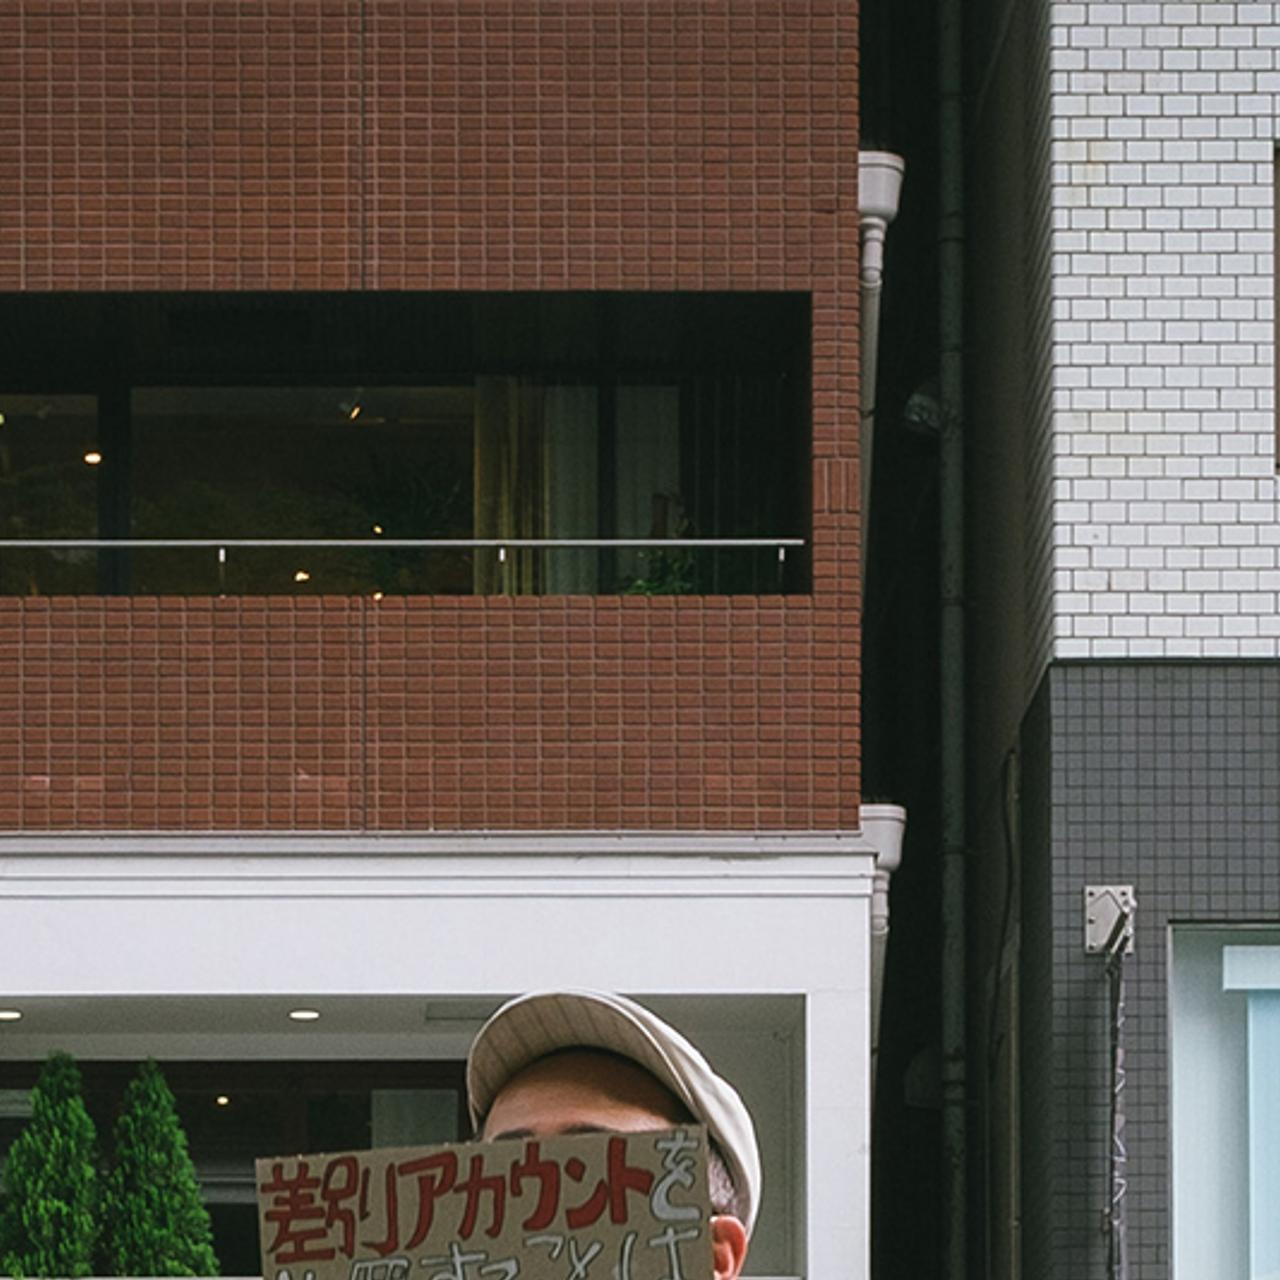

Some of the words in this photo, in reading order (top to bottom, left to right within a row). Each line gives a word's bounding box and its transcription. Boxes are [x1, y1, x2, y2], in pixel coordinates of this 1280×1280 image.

[260, 1131, 701, 1264] 差別アカウントを
